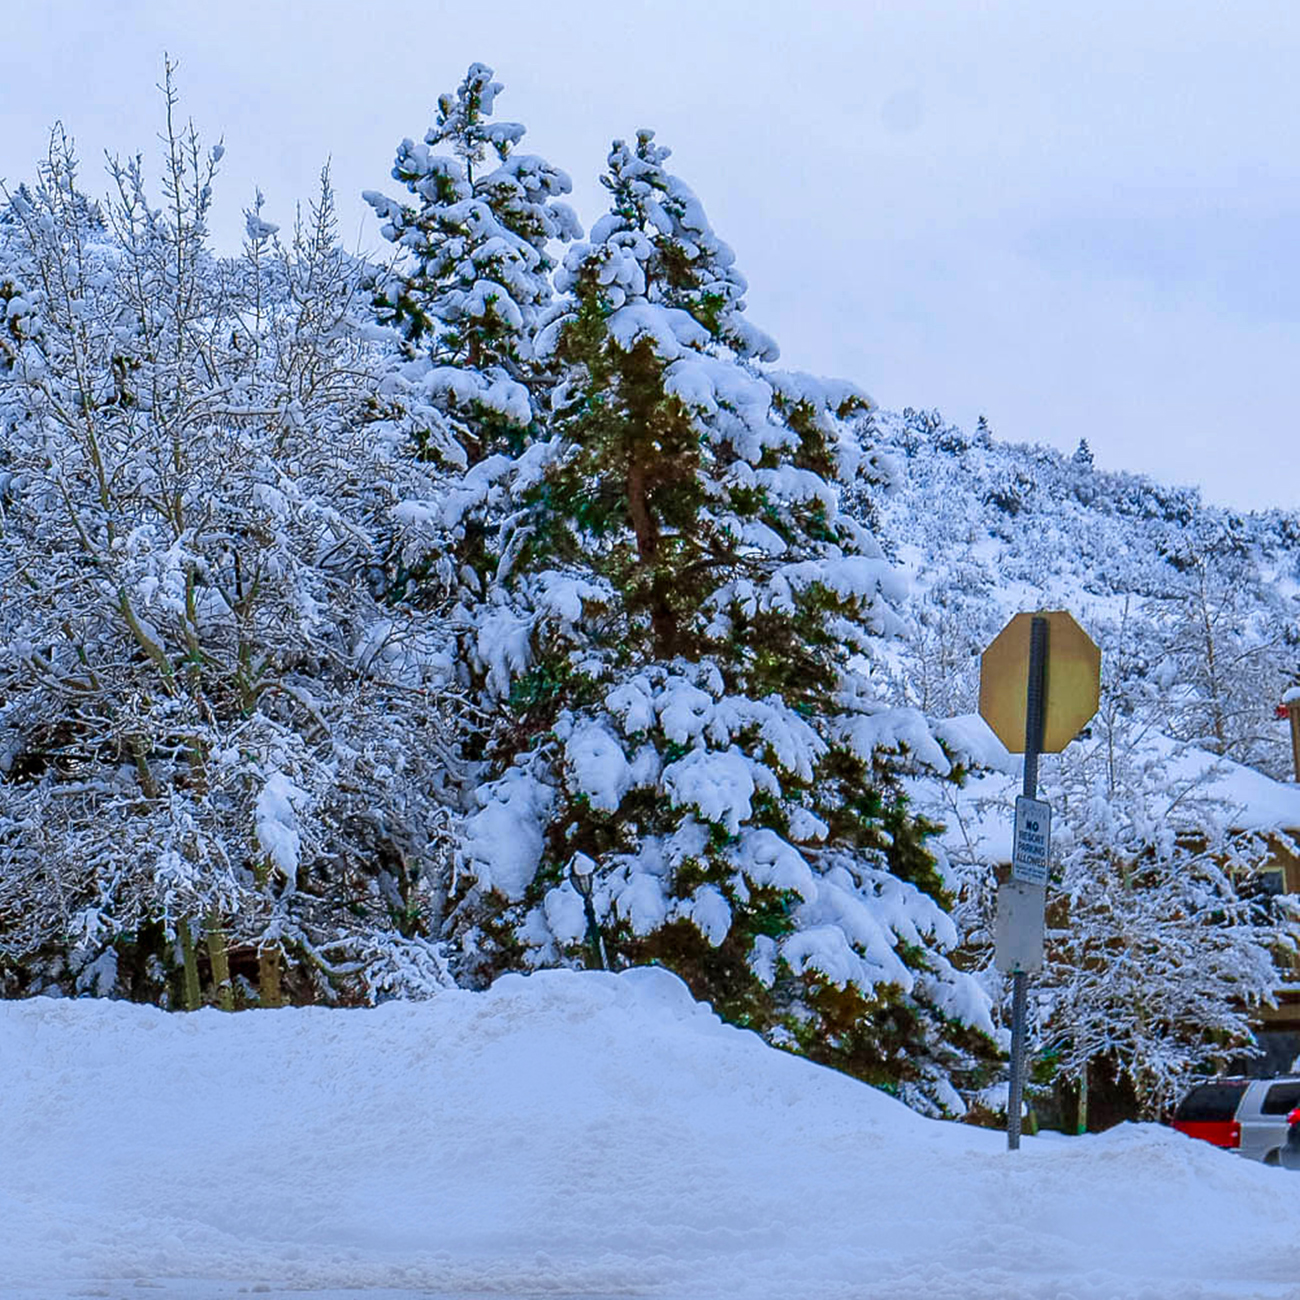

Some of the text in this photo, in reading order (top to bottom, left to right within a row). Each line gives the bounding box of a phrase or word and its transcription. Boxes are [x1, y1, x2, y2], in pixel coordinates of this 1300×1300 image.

[1026, 820, 1039, 832] NO
[1018, 841, 1045, 857] PARKING
[1016, 852, 1046, 868] ALLOWED
